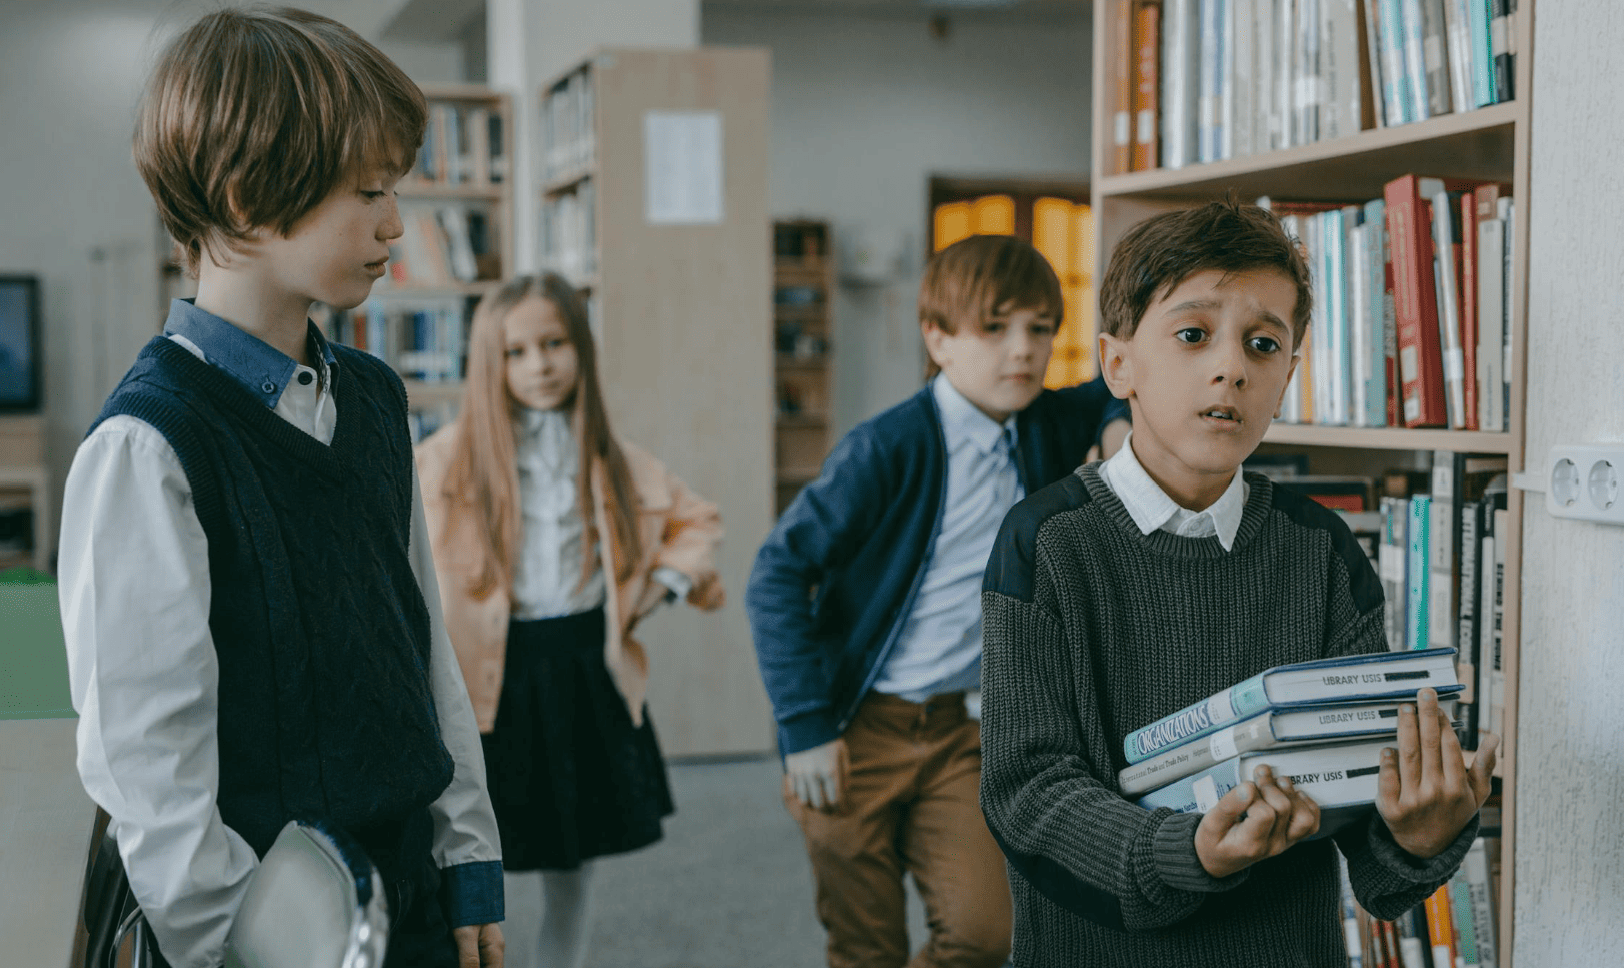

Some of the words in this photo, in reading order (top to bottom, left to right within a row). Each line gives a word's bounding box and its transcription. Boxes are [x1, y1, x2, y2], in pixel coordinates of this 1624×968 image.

[1322, 674, 1359, 686] LIBRARY
[1361, 673, 1382, 684] USIS
[1319, 712, 1354, 725] LIBRARY
[1356, 710, 1376, 721] USIS
[1138, 704, 1209, 755] ORGANIZATIONS
[1290, 774, 1321, 785] BRARY
[1323, 771, 1343, 782] USIS
